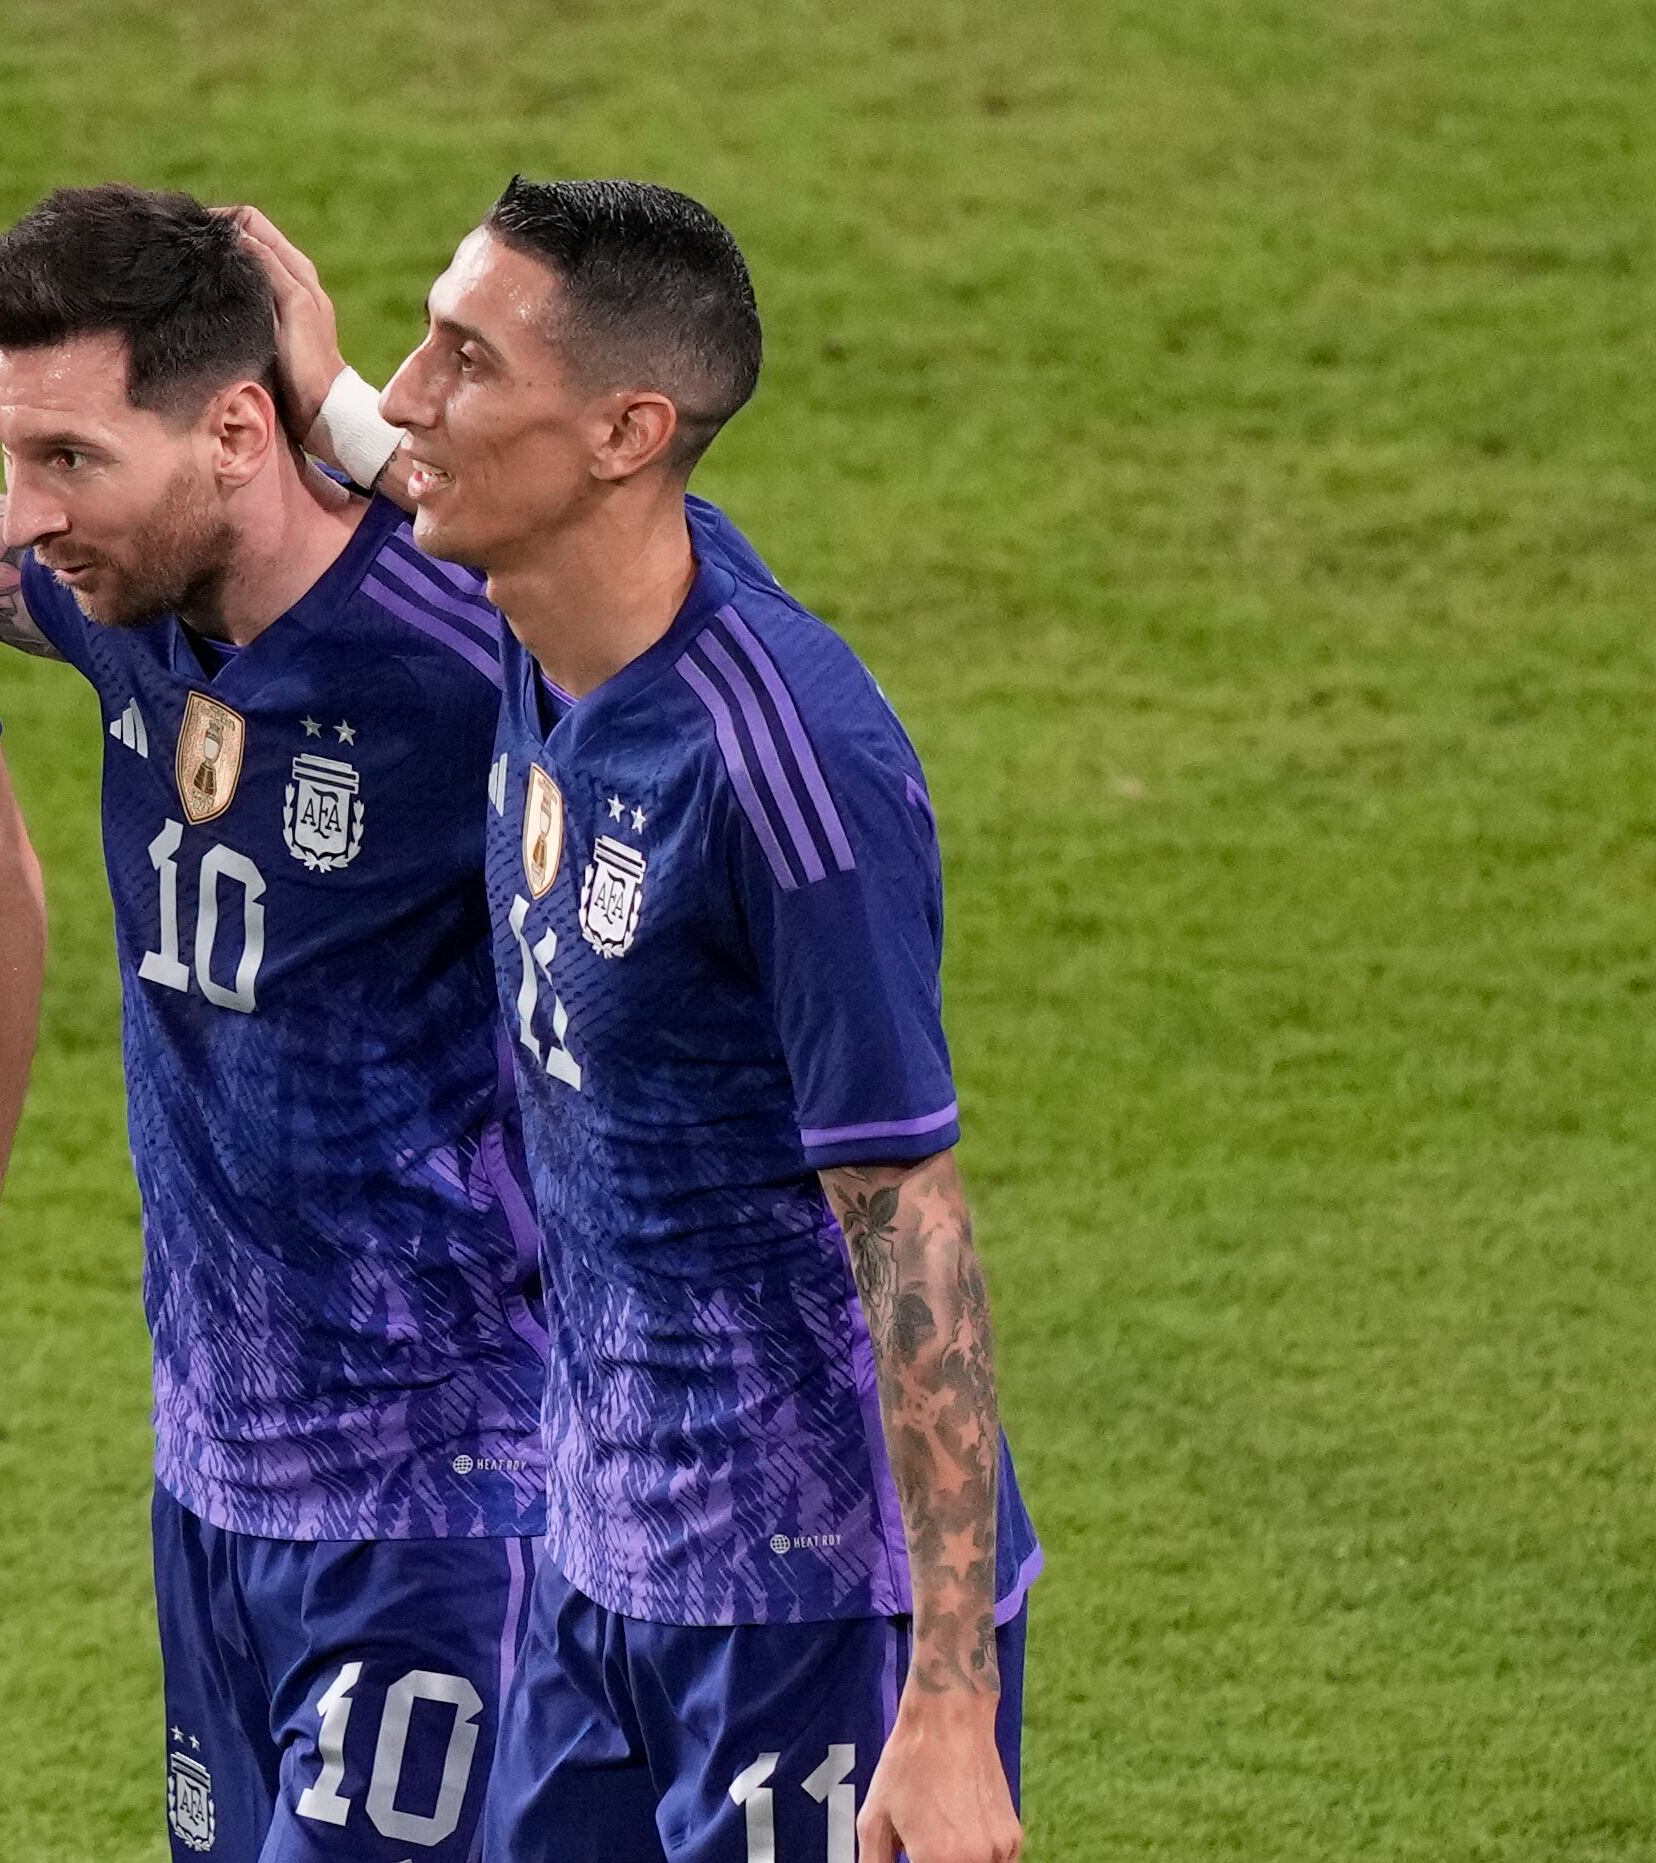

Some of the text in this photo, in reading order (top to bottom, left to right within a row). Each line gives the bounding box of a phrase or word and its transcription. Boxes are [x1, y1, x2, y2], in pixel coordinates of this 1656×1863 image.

[300, 785, 342, 840] AFA
[138, 818, 267, 1014] 10
[594, 869, 626, 925] AFA
[508, 894, 581, 1091] 11
[295, 1661, 484, 1847] 10
[728, 1743, 855, 1863] 11
